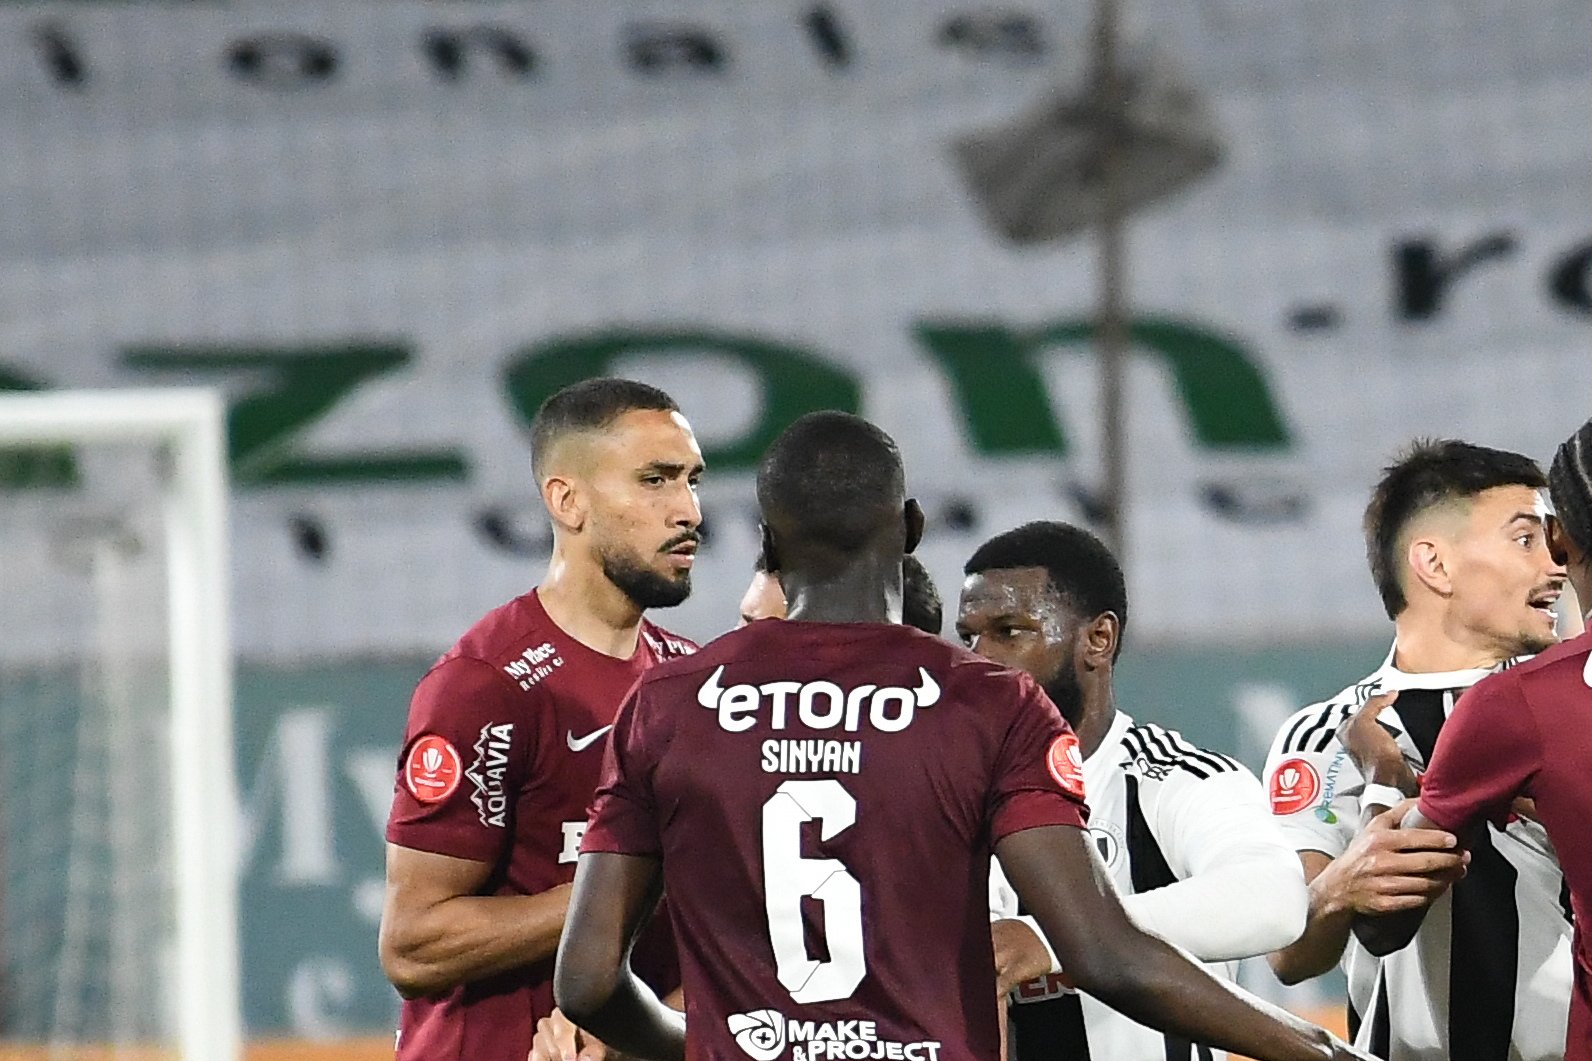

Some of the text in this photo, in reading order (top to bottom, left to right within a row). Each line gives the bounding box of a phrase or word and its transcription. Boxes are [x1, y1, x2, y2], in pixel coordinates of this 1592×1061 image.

[487, 723, 513, 827] AQUAVIA
[761, 739, 862, 774] SINYAN
[762, 779, 867, 1005] 6
[788, 1019, 878, 1043] MAKE
